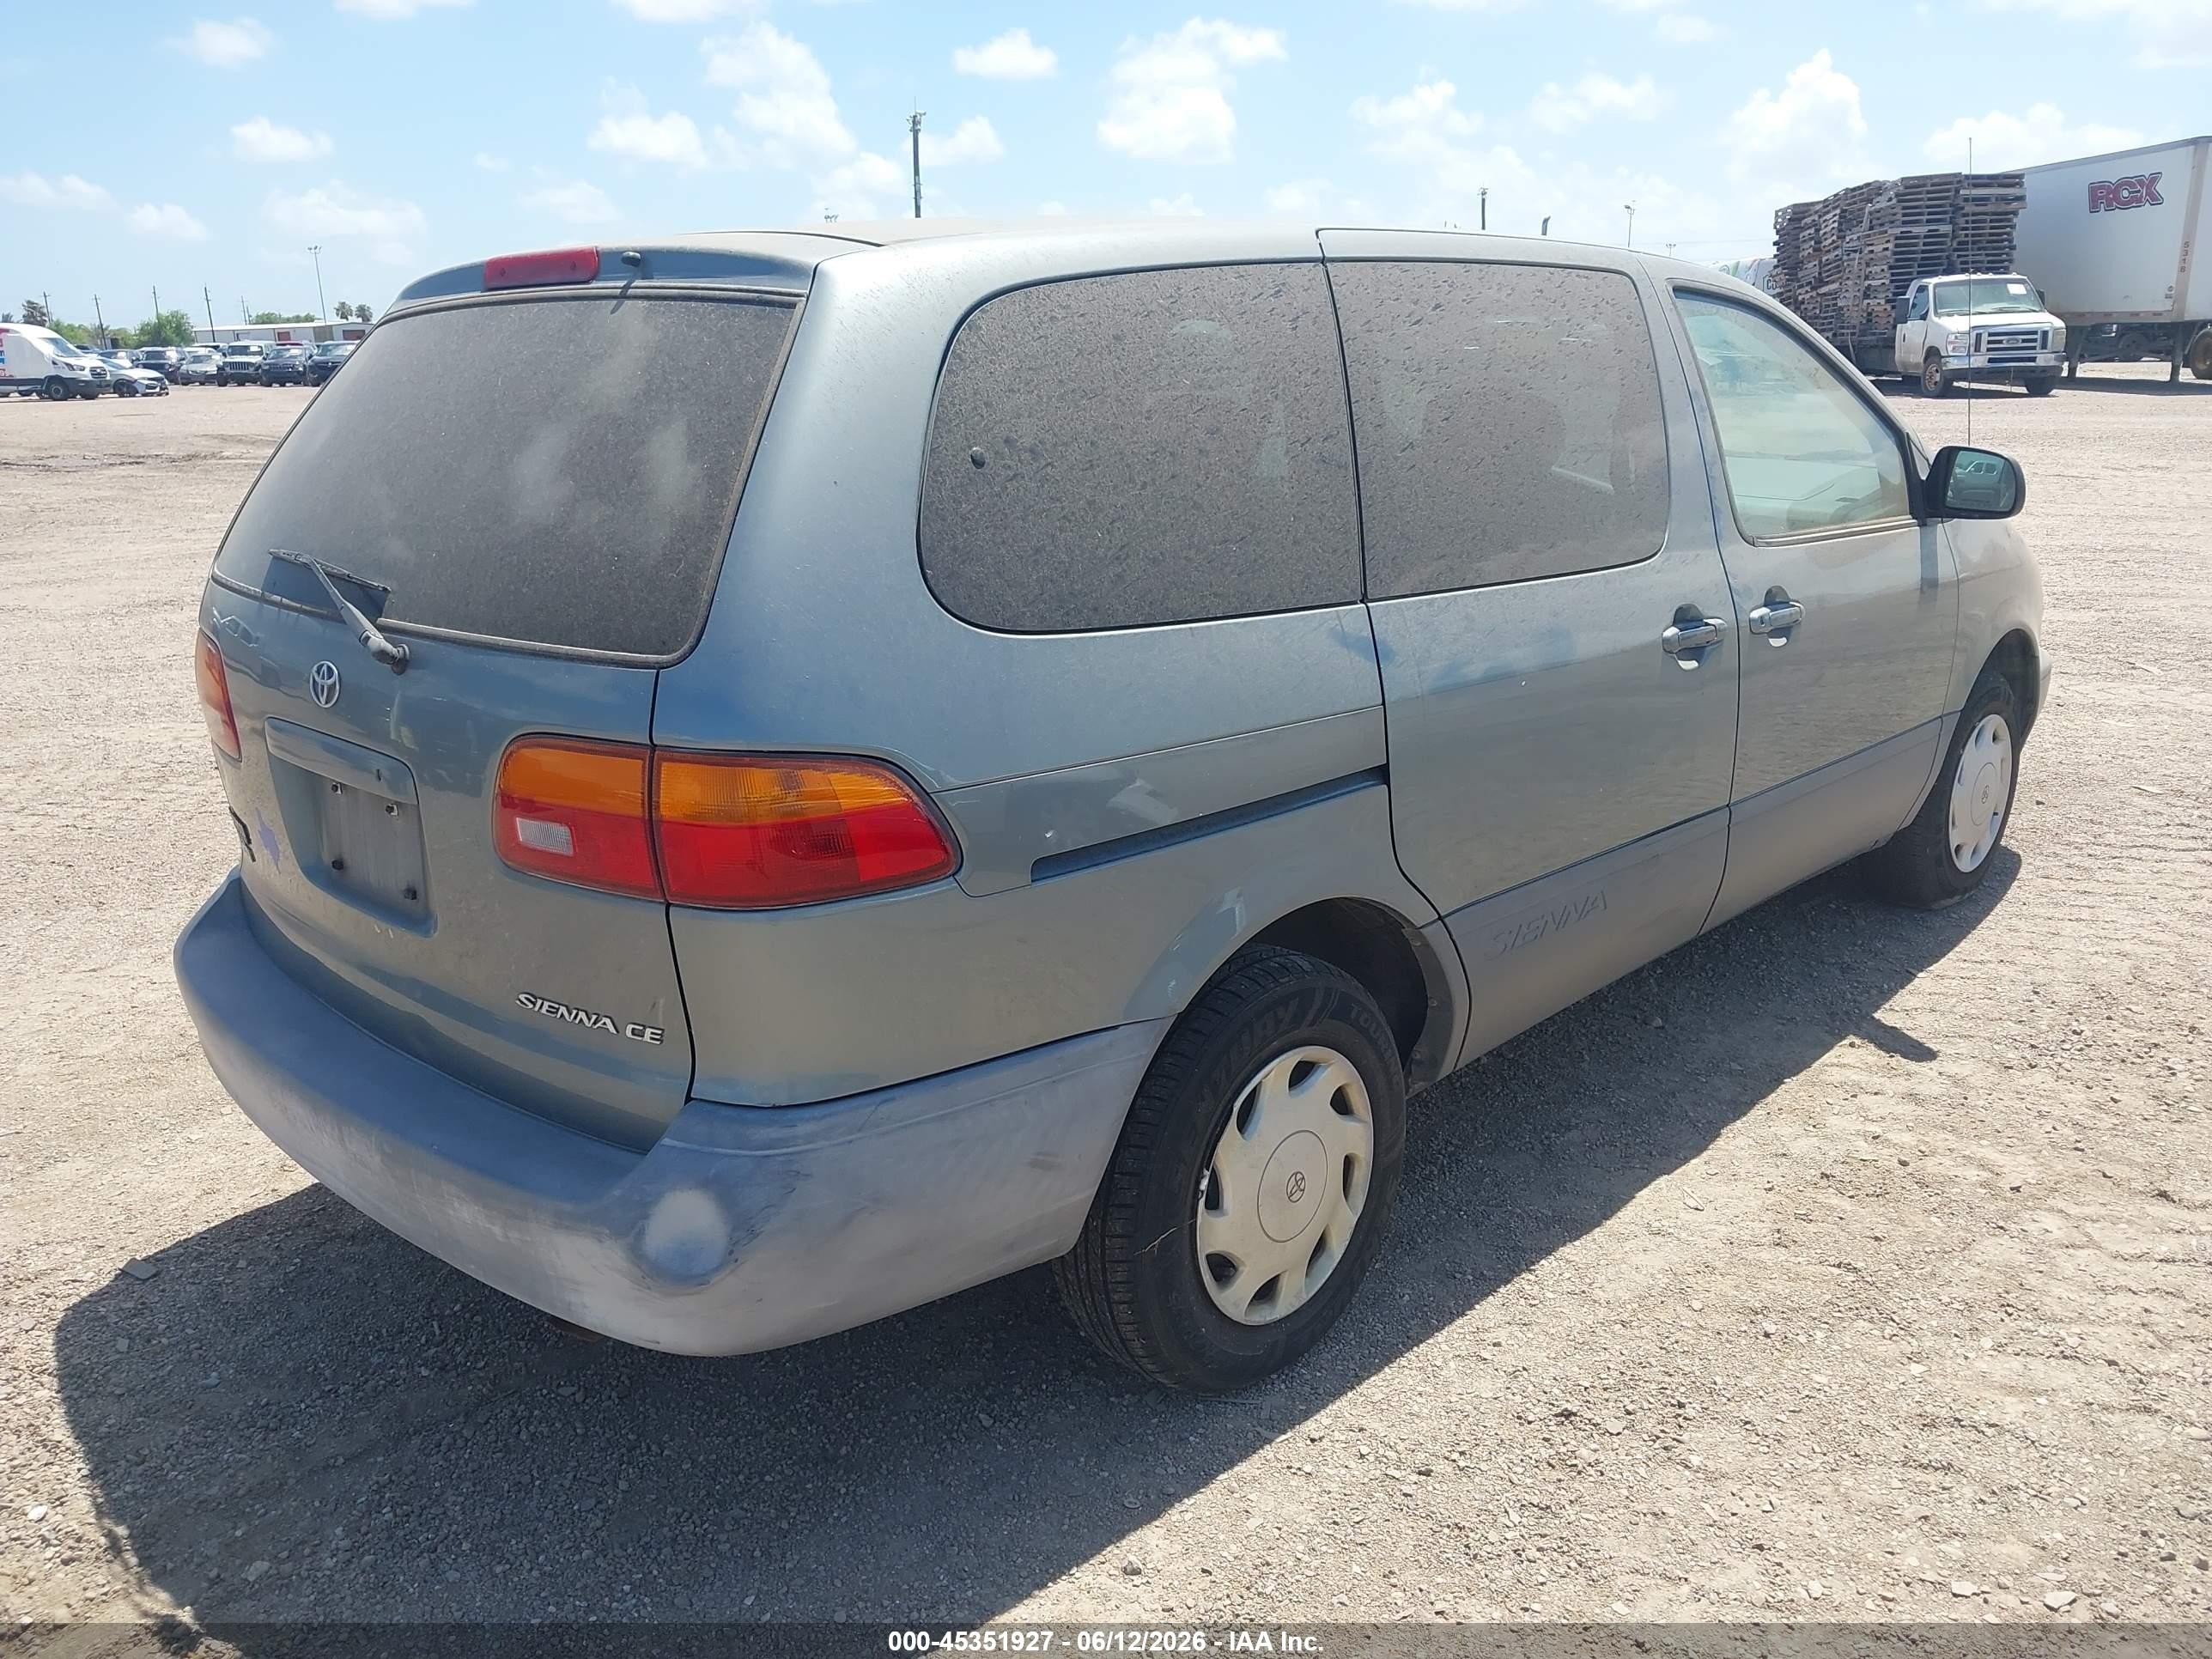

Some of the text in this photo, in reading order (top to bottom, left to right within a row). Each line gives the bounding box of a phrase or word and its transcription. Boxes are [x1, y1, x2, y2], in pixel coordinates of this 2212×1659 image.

[2088, 172, 2164, 213] RCX
[1484, 890, 1608, 961] SIENNA
[514, 992, 665, 1045] SIENNA CE
